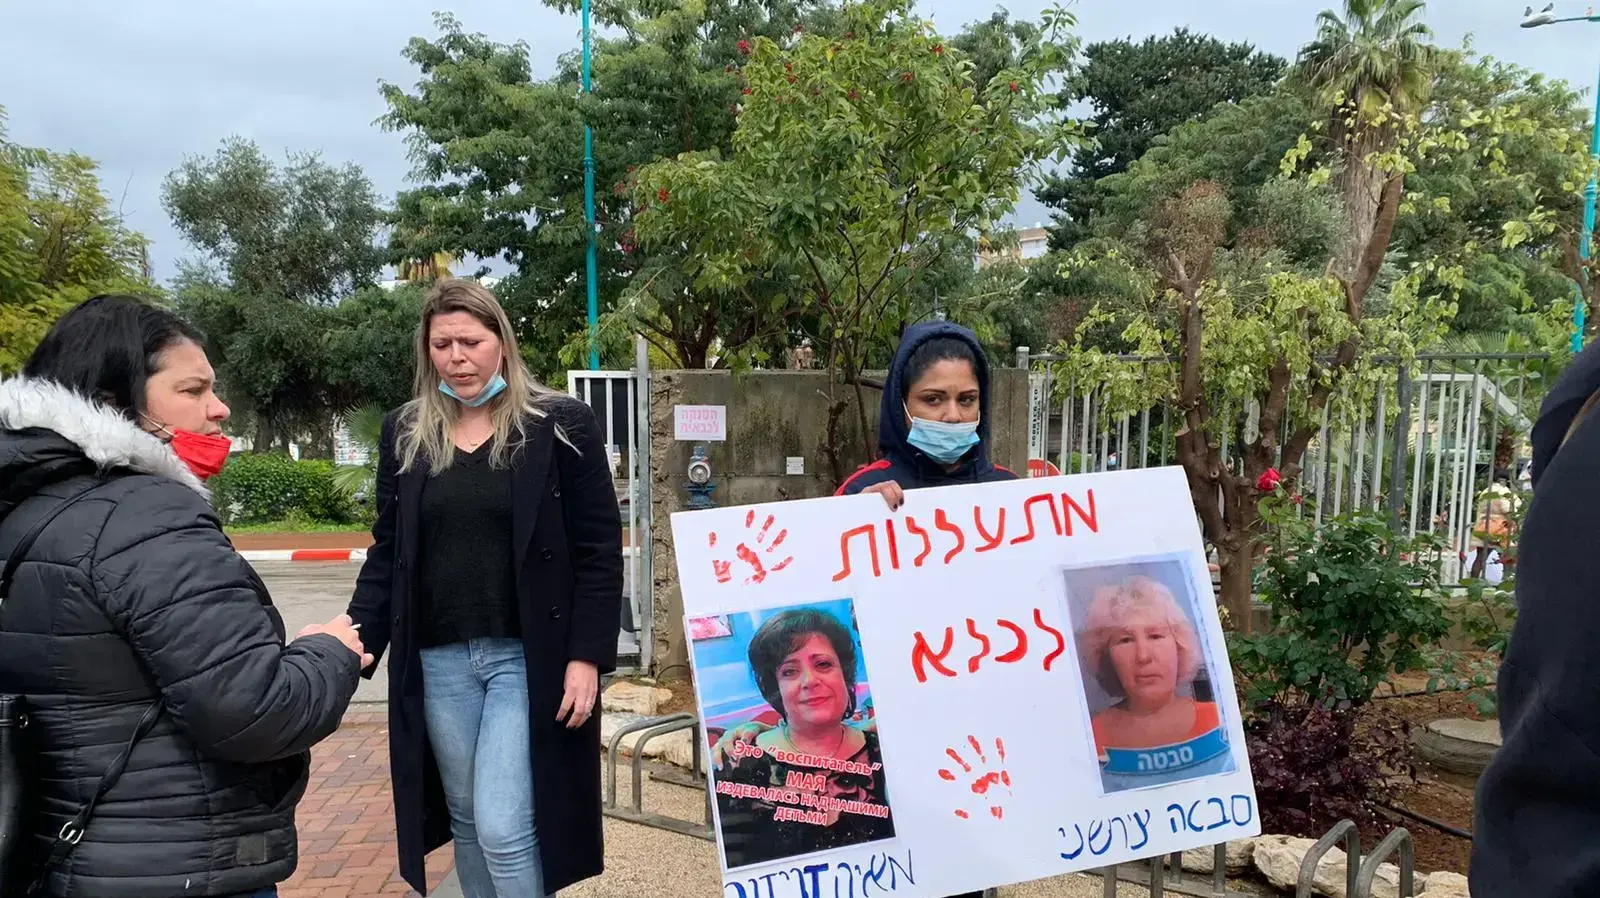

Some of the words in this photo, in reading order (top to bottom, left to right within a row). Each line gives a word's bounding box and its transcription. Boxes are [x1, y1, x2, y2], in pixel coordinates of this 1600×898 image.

[832, 489, 1099, 582] מתעללות
[911, 608, 1065, 683] לכלא
[734, 740, 763, 758] Это
[1137, 745, 1194, 770] סבטה
[785, 771, 827, 791] МАЯ
[716, 780, 800, 804] ИЗДЕВАЛАСЬ
[800, 793, 829, 811] НАД
[829, 798, 889, 818] НАШИМИ
[774, 807, 828, 826] ДЕТЬМИ
[835, 848, 916, 898] מאיה
